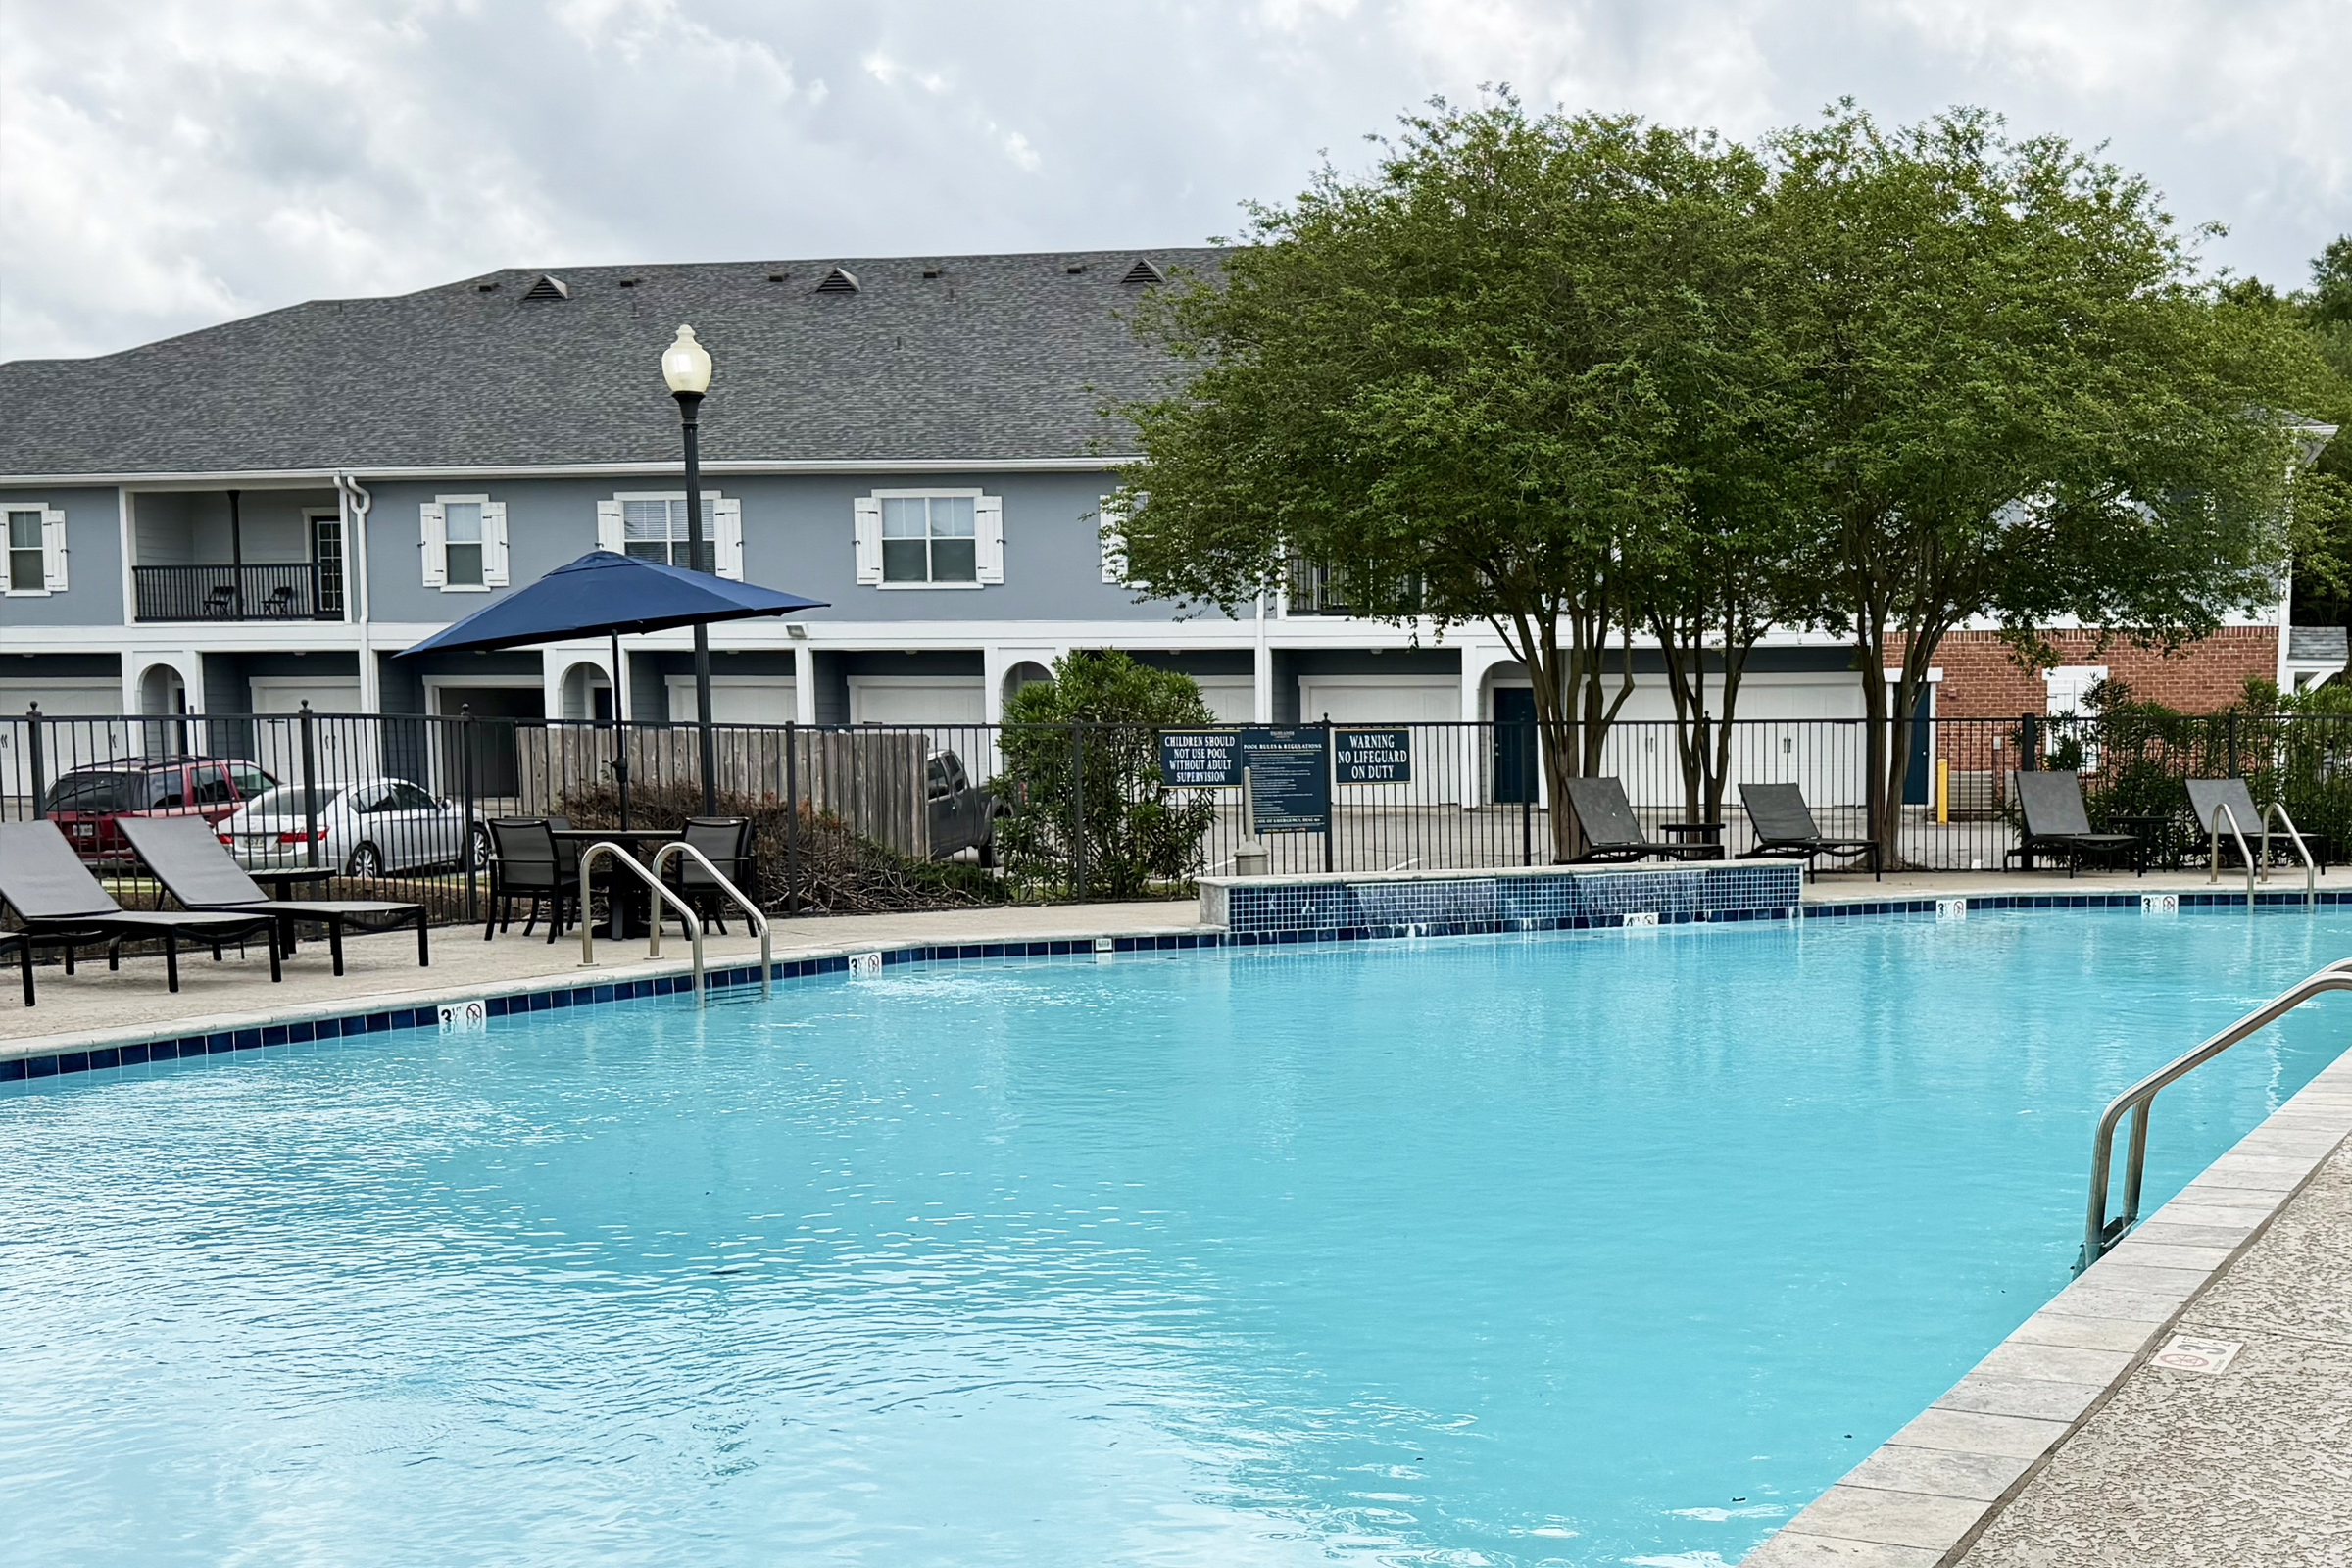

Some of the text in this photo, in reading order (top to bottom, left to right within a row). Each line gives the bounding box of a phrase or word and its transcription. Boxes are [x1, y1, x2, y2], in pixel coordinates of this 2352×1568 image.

[1164, 736, 1235, 747] CHILDREN SHOULD
[1349, 734, 1395, 748] WARNING
[1174, 748, 1227, 759] NOT USE POOL
[1338, 750, 1407, 764] NO LIFEGUARD
[1169, 760, 1232, 770] WITHOUT ADULT
[1176, 771, 1225, 783] SUPERVISION
[1351, 765, 1394, 779] ON DUTY
